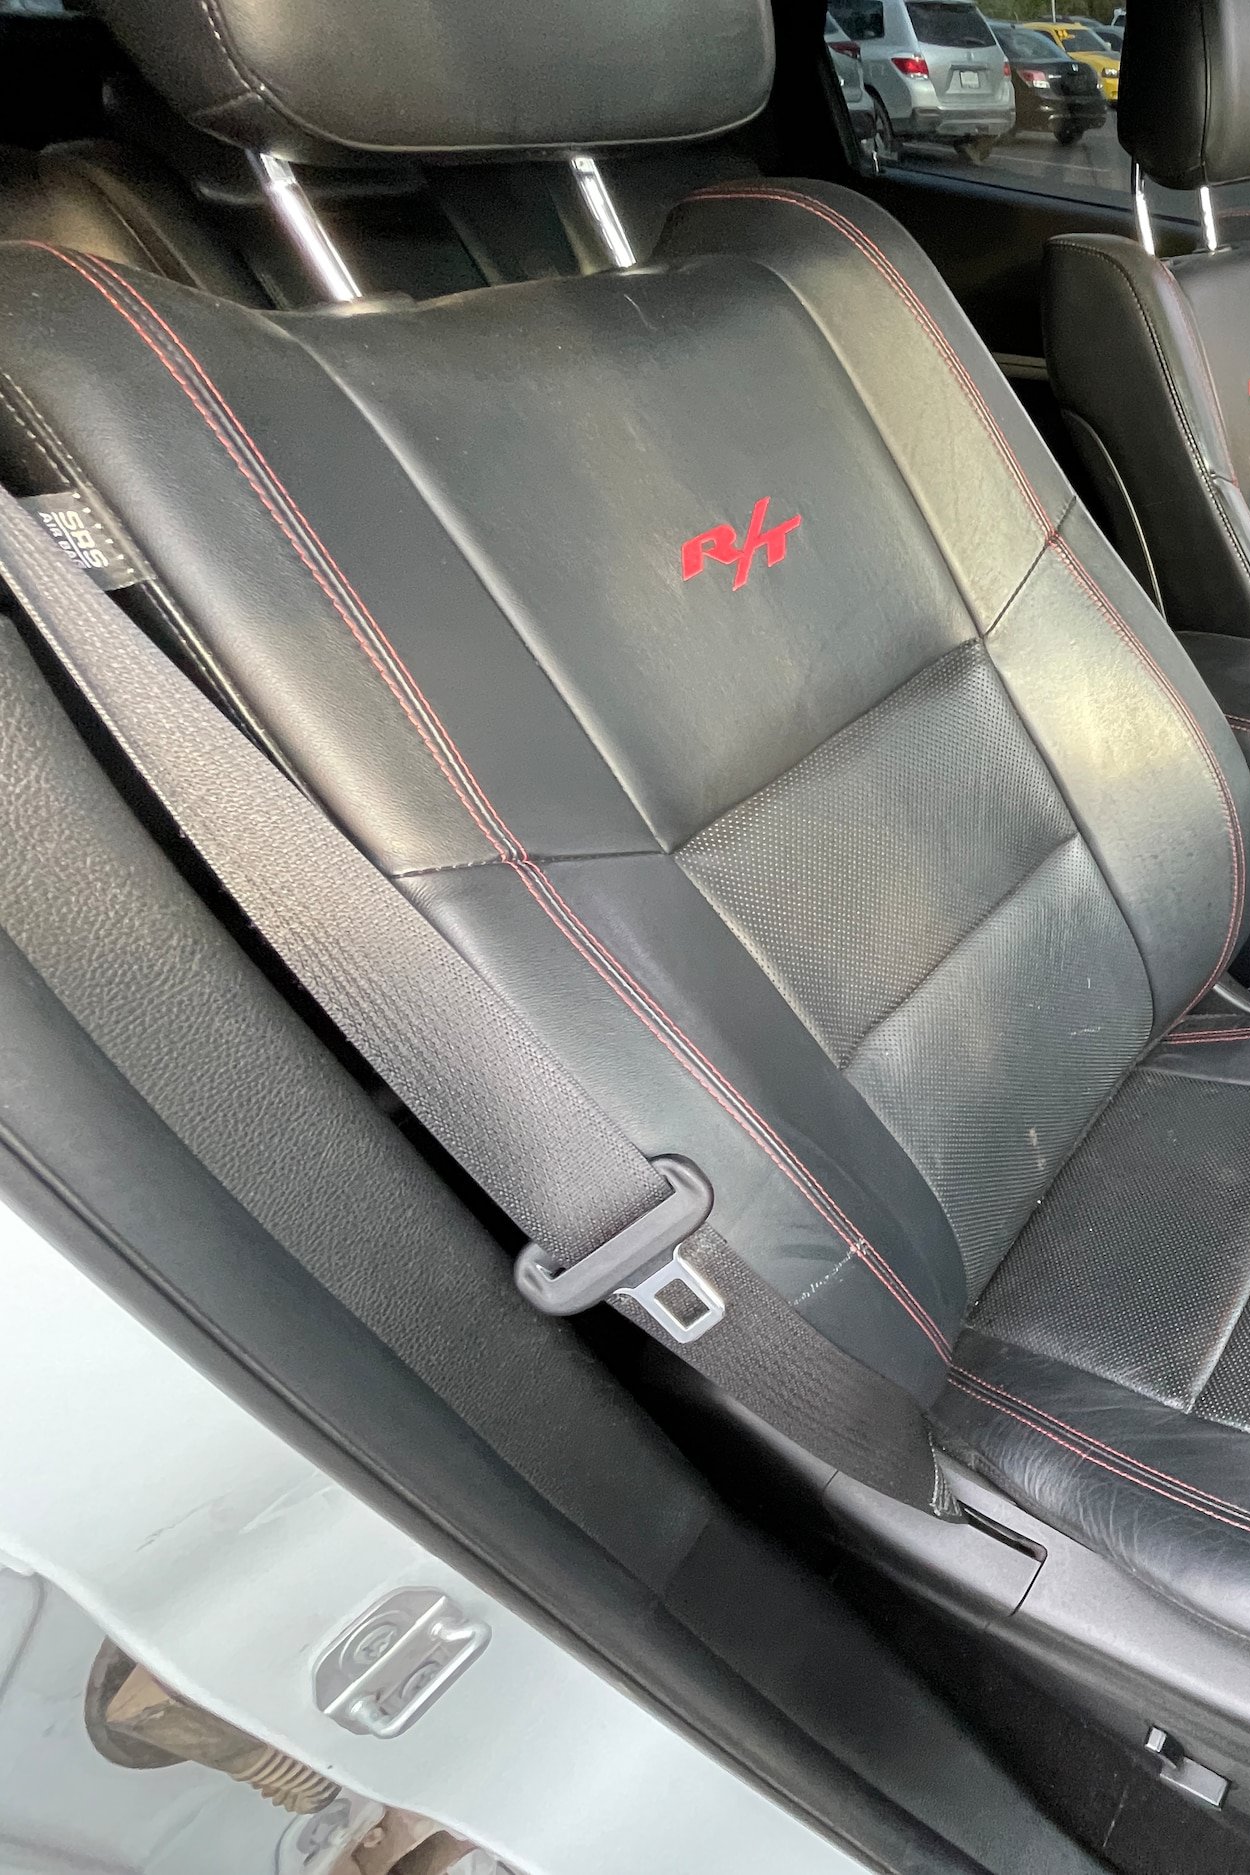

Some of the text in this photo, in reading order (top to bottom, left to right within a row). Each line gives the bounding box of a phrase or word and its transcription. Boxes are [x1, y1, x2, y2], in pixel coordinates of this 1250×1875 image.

[38, 512, 63, 538] AIR
[58, 510, 109, 568] SRS
[681, 496, 802, 591] R/T
